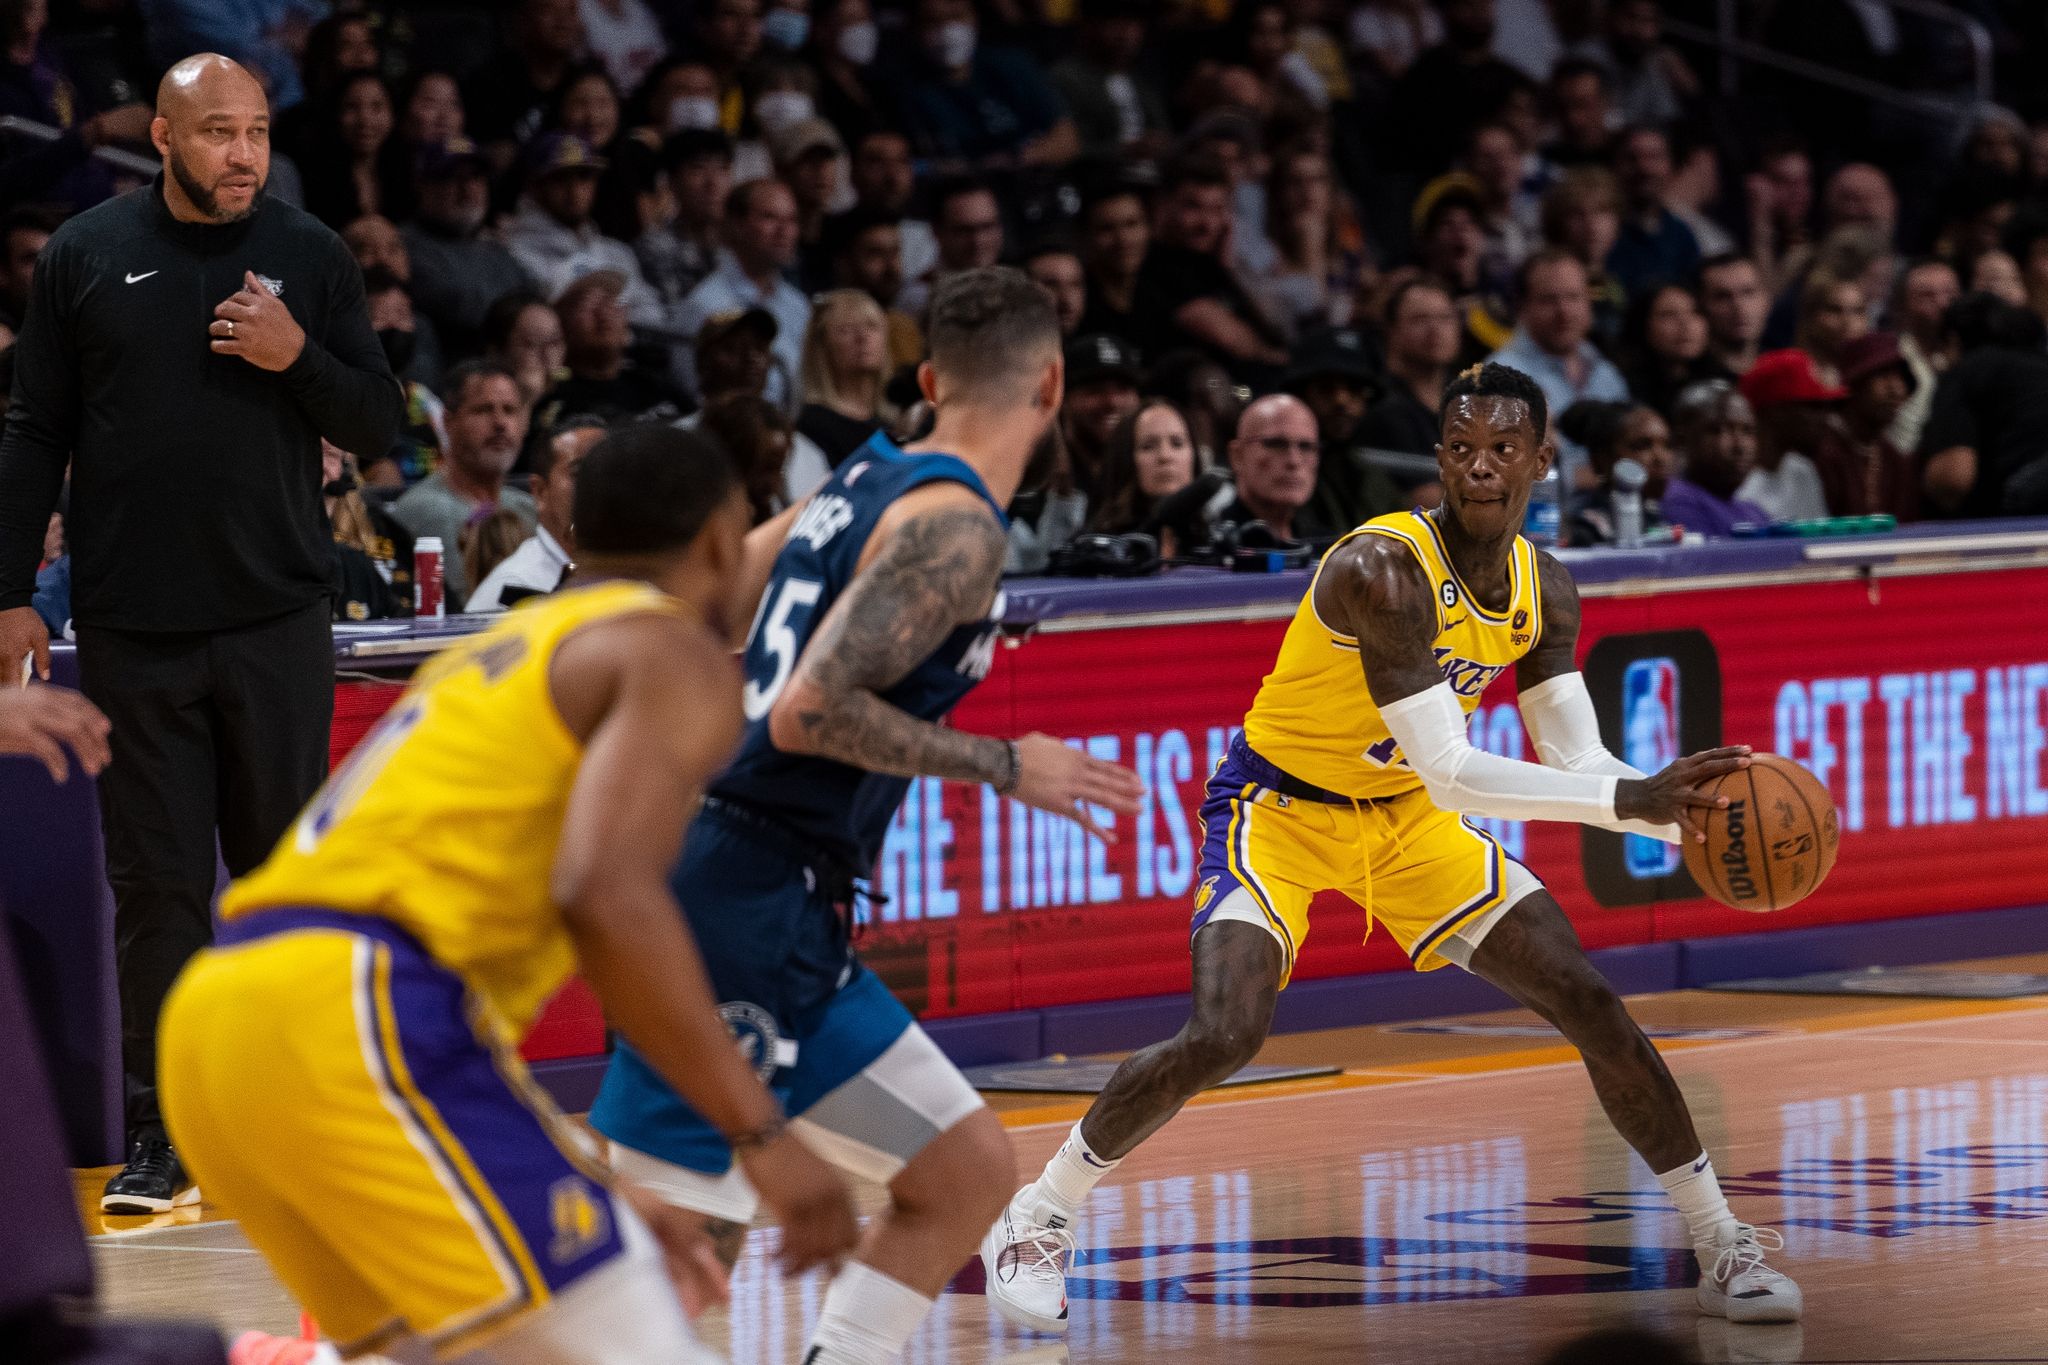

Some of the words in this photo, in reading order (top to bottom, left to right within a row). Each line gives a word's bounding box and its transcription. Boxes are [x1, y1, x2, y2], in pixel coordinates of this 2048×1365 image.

[1443, 583, 1455, 606] 6
[1878, 667, 1977, 828] THE
[1134, 729, 1195, 898] IS
[1722, 800, 1758, 900] Wilson
